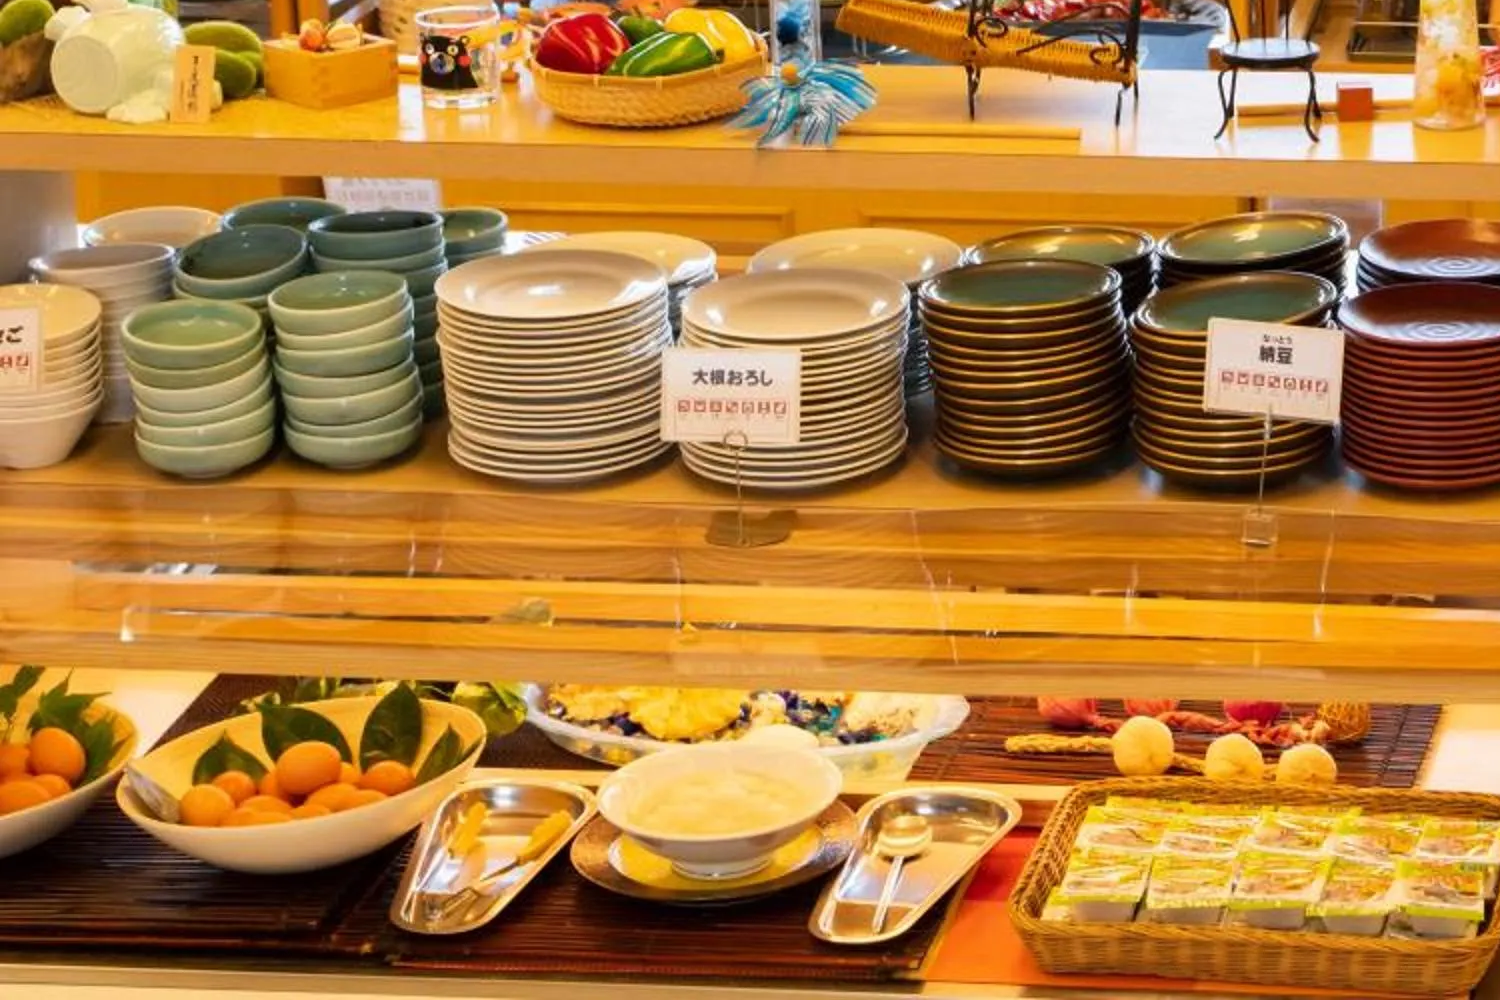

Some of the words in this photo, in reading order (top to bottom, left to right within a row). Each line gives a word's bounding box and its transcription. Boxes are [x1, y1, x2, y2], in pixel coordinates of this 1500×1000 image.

[1259, 345, 1293, 365] 納豆
[691, 369, 773, 387] 大根おろし
